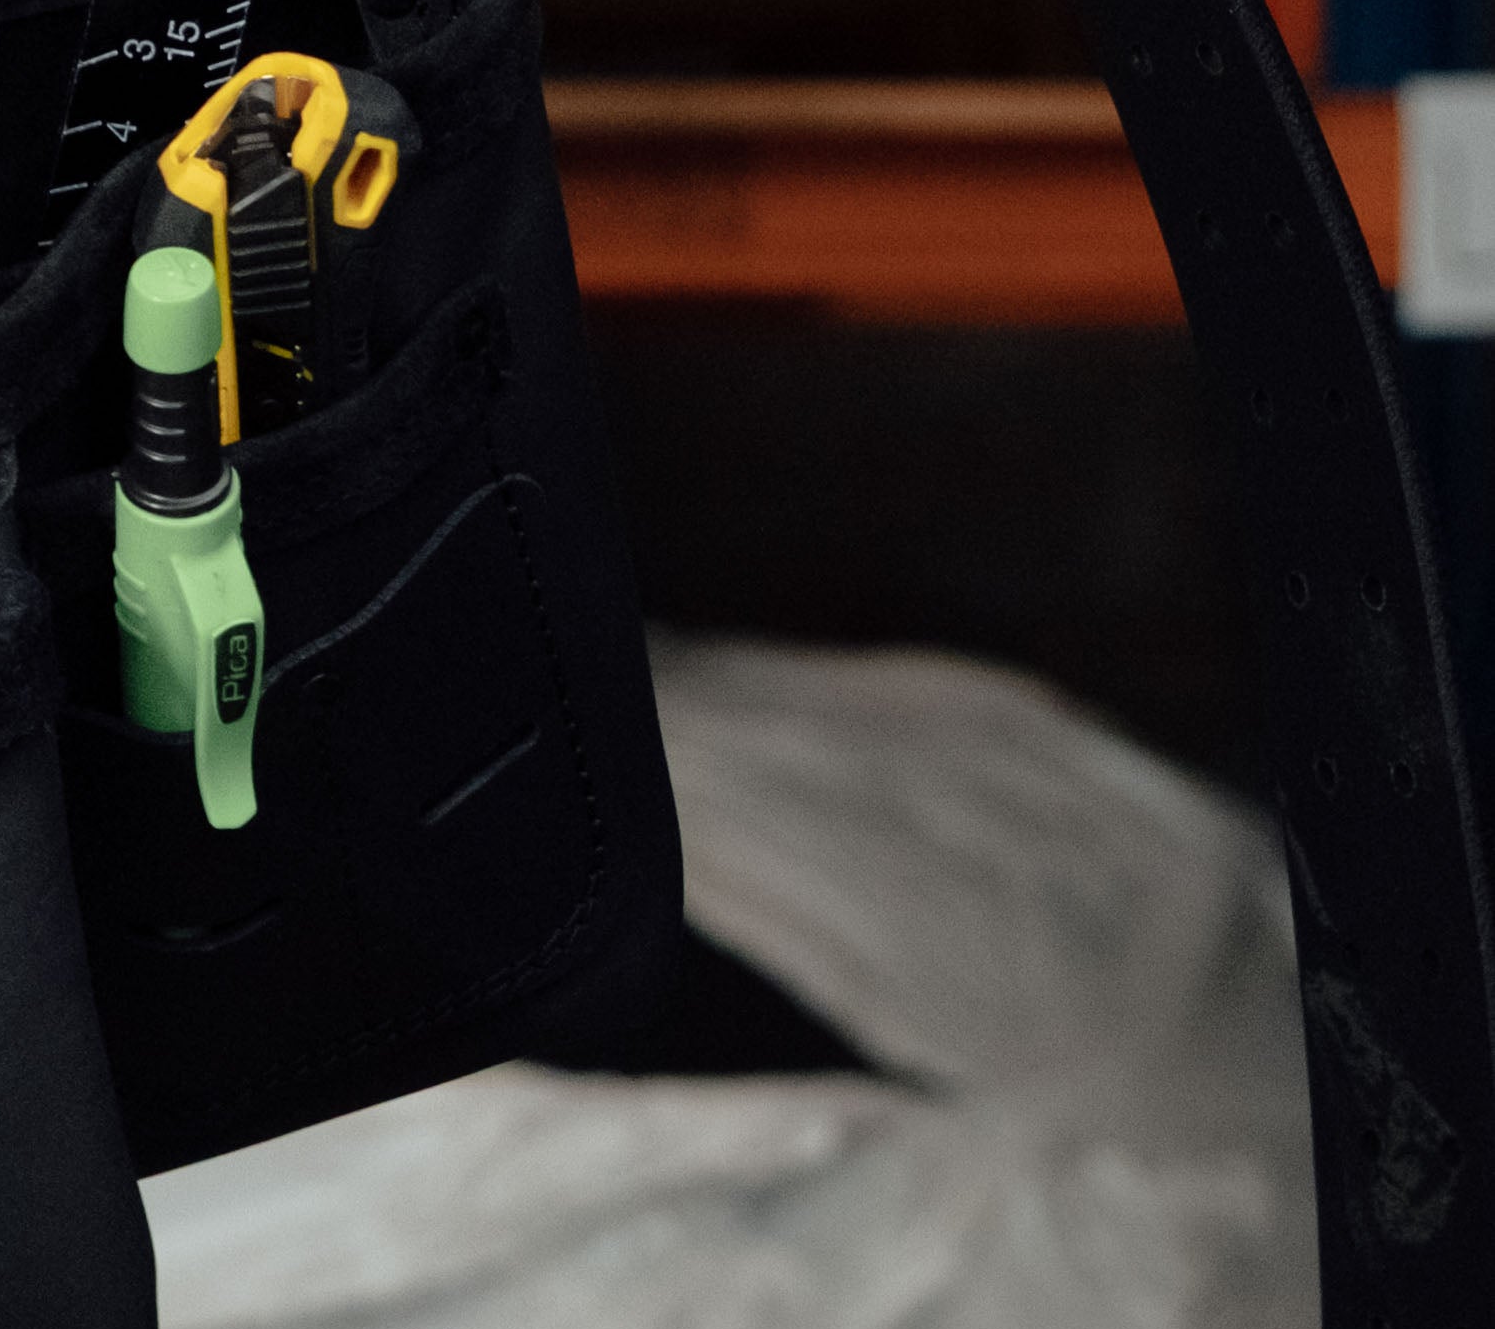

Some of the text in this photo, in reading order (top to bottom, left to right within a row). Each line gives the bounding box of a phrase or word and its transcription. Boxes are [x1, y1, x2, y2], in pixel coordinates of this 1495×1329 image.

[123, 39, 156, 61] 3
[163, 20, 200, 61] 15
[106, 120, 137, 142] 4
[222, 634, 248, 702] Pica
